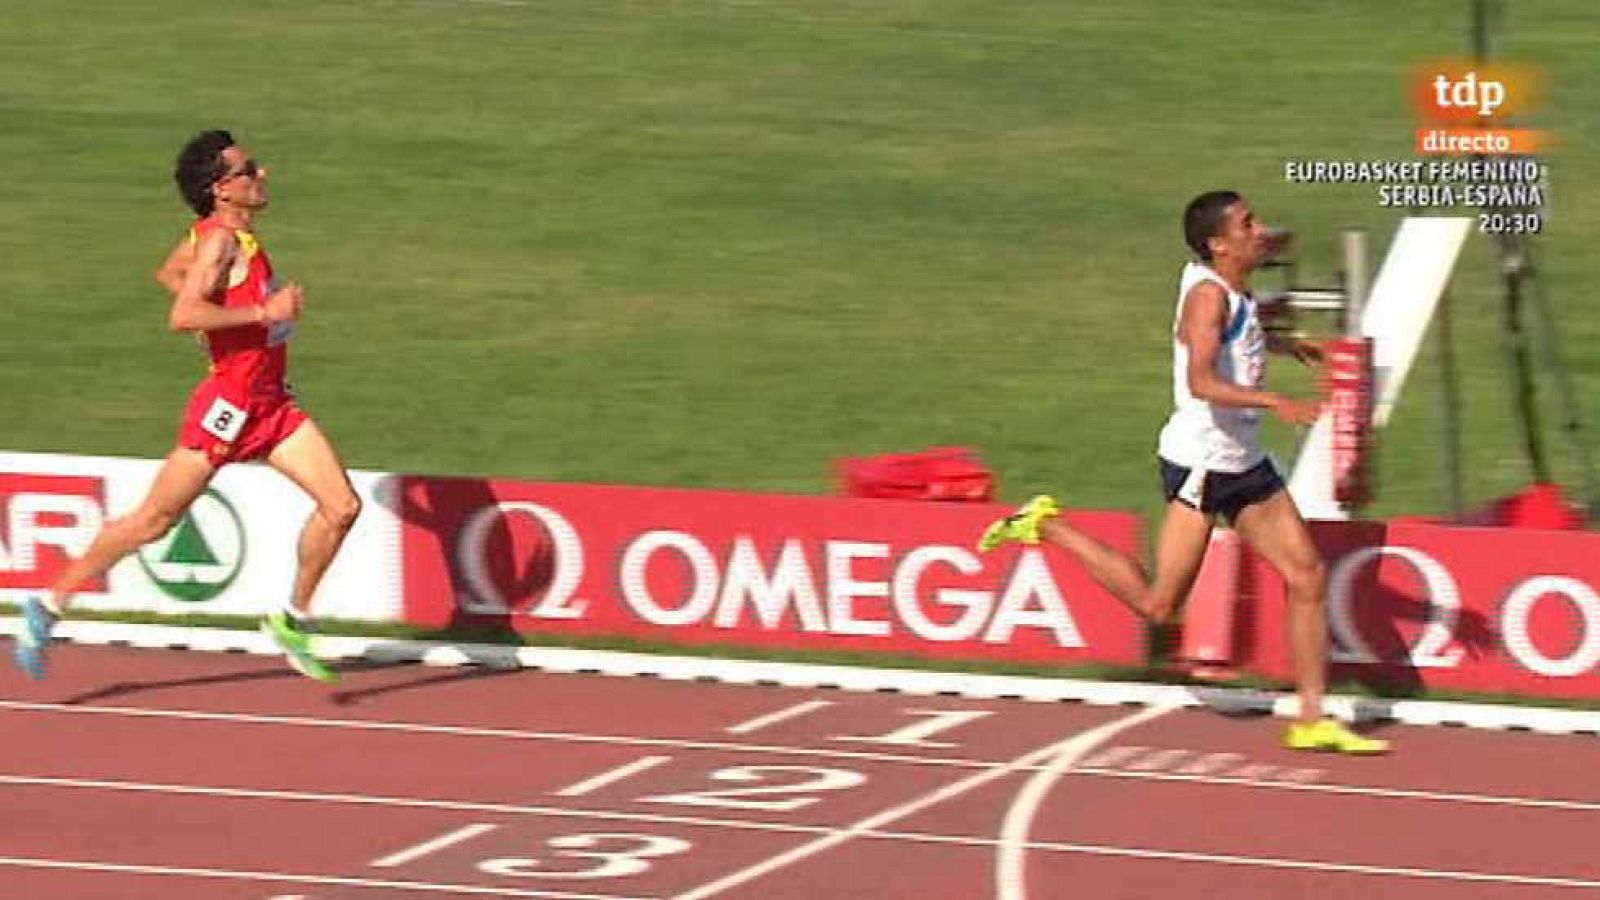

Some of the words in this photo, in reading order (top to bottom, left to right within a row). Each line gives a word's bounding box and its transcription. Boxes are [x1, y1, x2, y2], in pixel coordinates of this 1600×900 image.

[214, 410, 234, 432] 8
[620, 530, 1087, 648] OMEGA
[826, 710, 995, 748] 1
[634, 765, 867, 811] 2
[477, 832, 692, 879] 3
